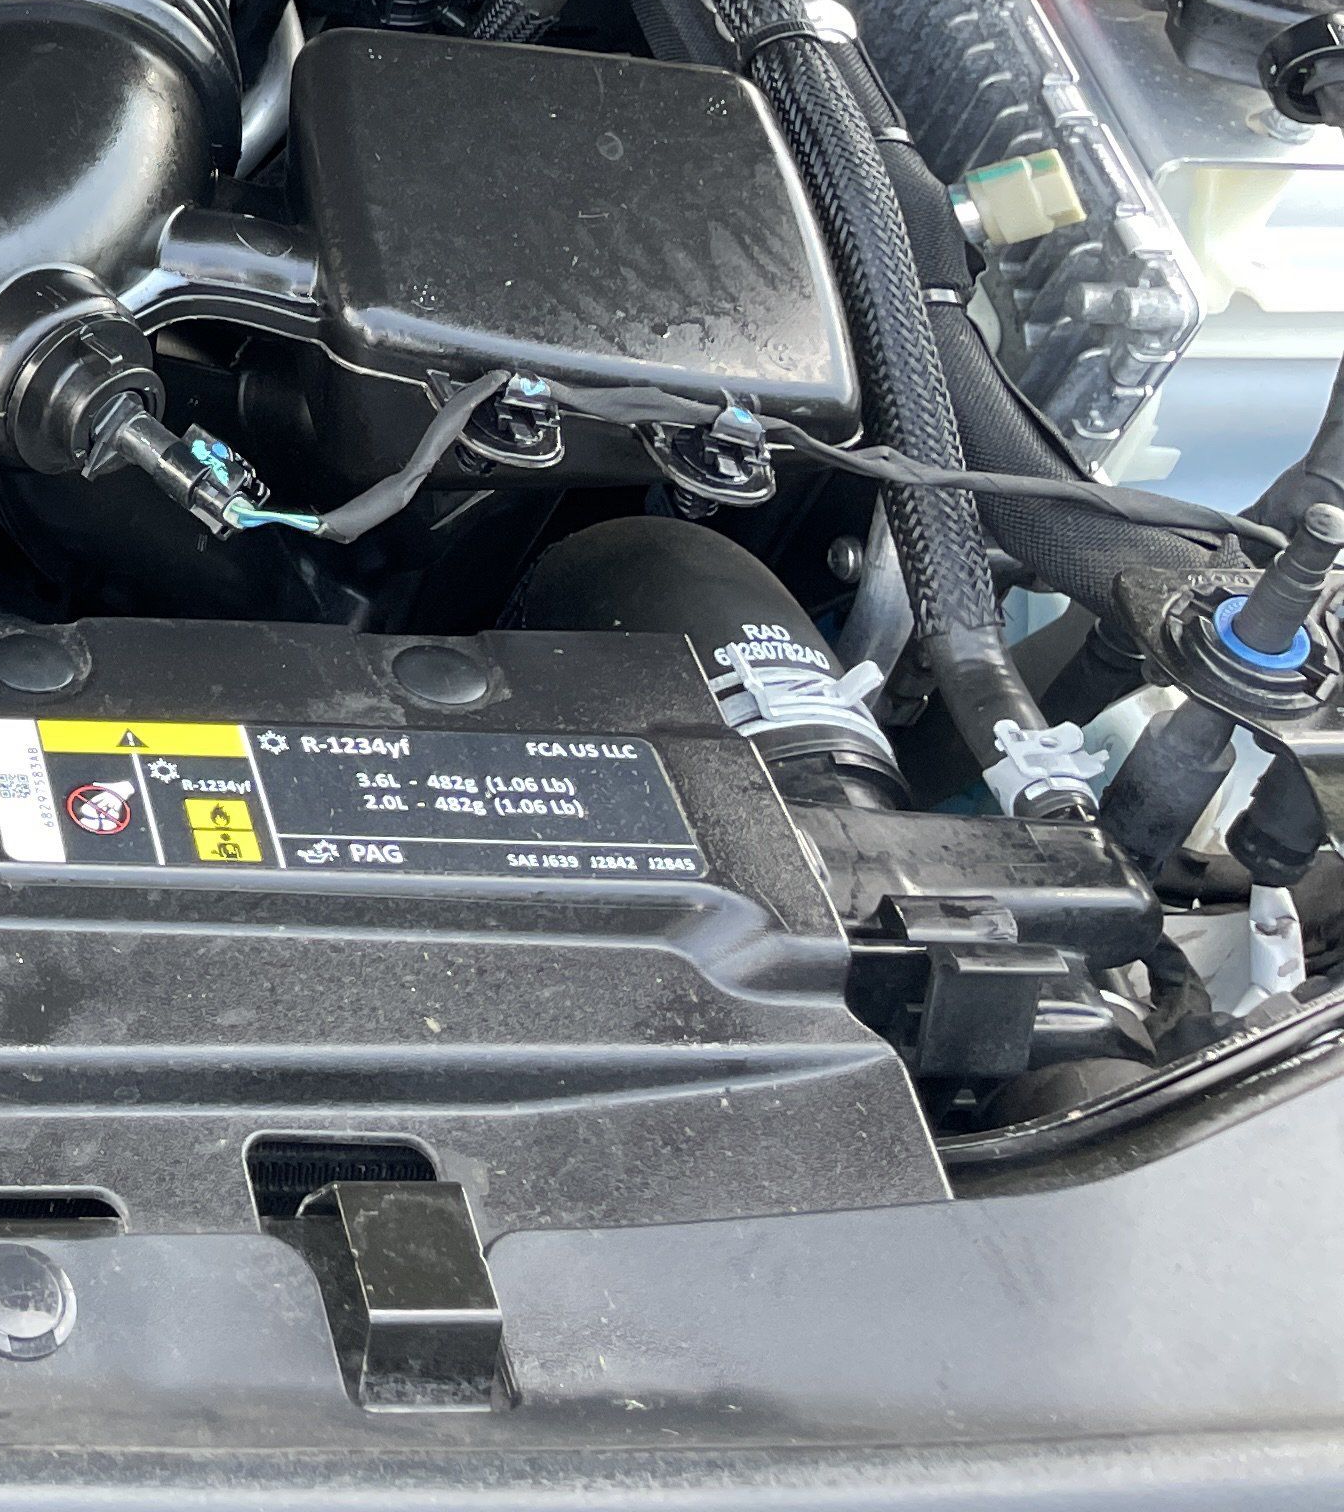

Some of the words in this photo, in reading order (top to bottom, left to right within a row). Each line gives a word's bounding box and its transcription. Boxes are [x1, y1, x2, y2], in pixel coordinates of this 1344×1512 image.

[741, 624, 791, 641] RAD
[713, 641, 831, 671] 6280782AD
[300, 735, 410, 759] R-1234yf
[525, 742, 568, 757] FCA
[569, 743, 599, 758] US
[602, 744, 638, 759] LLC
[181, 779, 252, 795] R-1234yf
[355, 772, 402, 789] 3.6L
[426, 774, 479, 793] 482g
[485, 775, 539, 794] (1.06
[541, 777, 575, 796] Lb)
[363, 794, 409, 811] 2.0L
[434, 796, 487, 816] 482g
[494, 797, 548, 817] (1.06
[550, 799, 585, 819] Lb)
[348, 844, 405, 864] PAG
[505, 853, 540, 868] SAE
